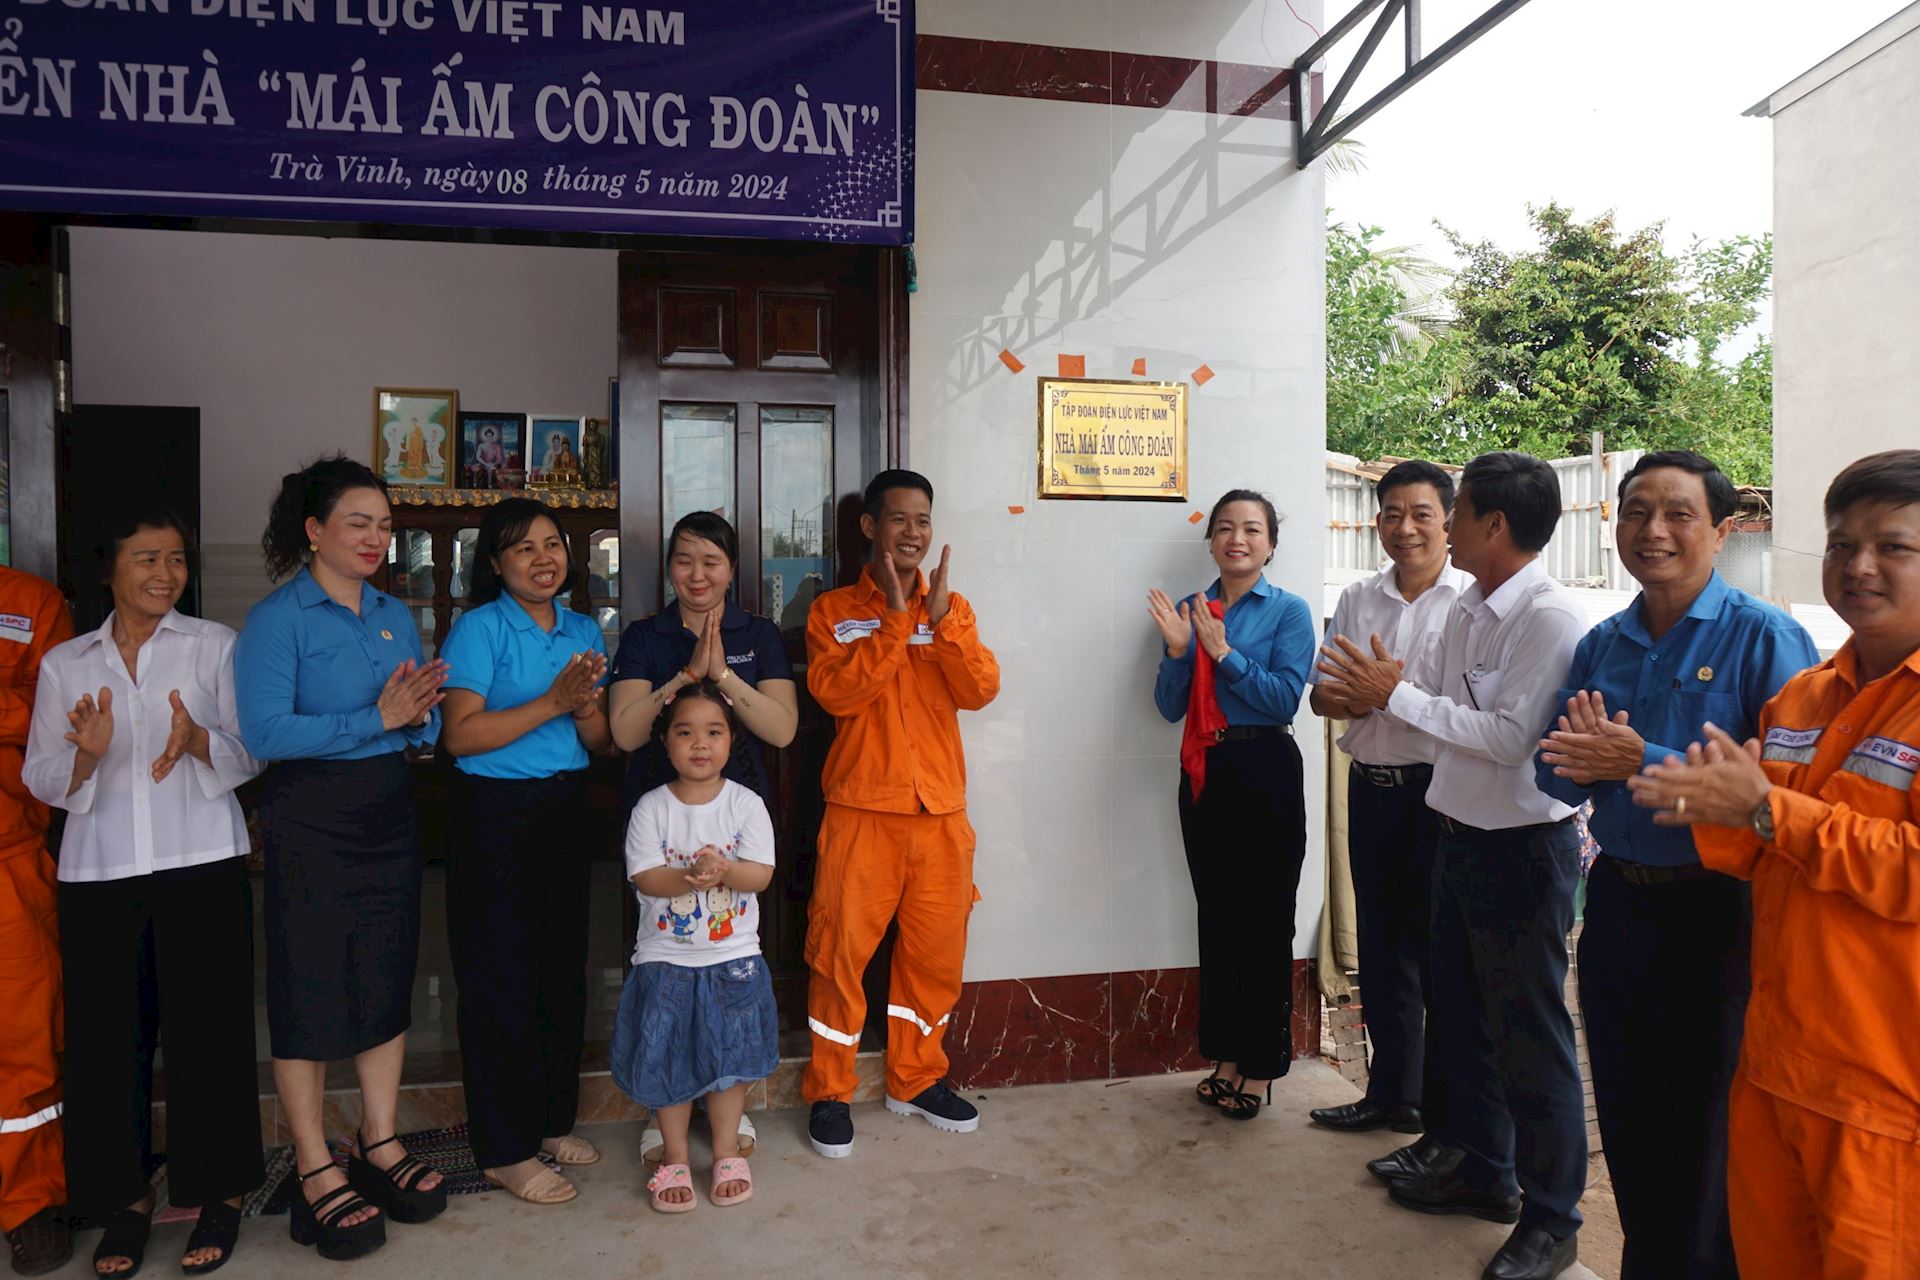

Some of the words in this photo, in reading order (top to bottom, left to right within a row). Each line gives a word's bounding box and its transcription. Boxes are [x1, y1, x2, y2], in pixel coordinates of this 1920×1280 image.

[582, 5, 685, 45] NAM
[100, 48, 235, 126] NHÀ
[259, 57, 403, 134] “MÁI
[420, 51, 514, 139] ẤM
[535, 71, 691, 148] CÔNG
[709, 83, 880, 157] ĐOÀN”
[270, 153, 324, 181] Trà
[336, 155, 411, 190] Vinh,
[423, 162, 494, 193] ngày
[497, 169, 528, 194] 08
[543, 165, 627, 199] tháng
[635, 169, 652, 194] 5
[659, 171, 720, 197] năm
[728, 173, 789, 200] 2024
[1062, 402, 1076, 420] TẬP
[1078, 402, 1097, 418] ĐOÀN
[1100, 403, 1116, 422] ĐIỆN
[1118, 404, 1132, 422] LỰC
[1135, 404, 1149, 423] VIỆT
[1152, 409, 1167, 421] NAM
[1055, 427, 1075, 454] NHÀ
[1079, 428, 1098, 455] MÁI
[1100, 424, 1116, 455] ẤM
[1118, 430, 1145, 457] CÔNG
[1147, 431, 1174, 457] ĐOÀN
[1074, 464, 1100, 476] Tháng
[1104, 465, 1109, 475] 5
[1112, 465, 1130, 476] năm
[1133, 466, 1155, 476] 2024
[1872, 743, 1897, 758] EVN
